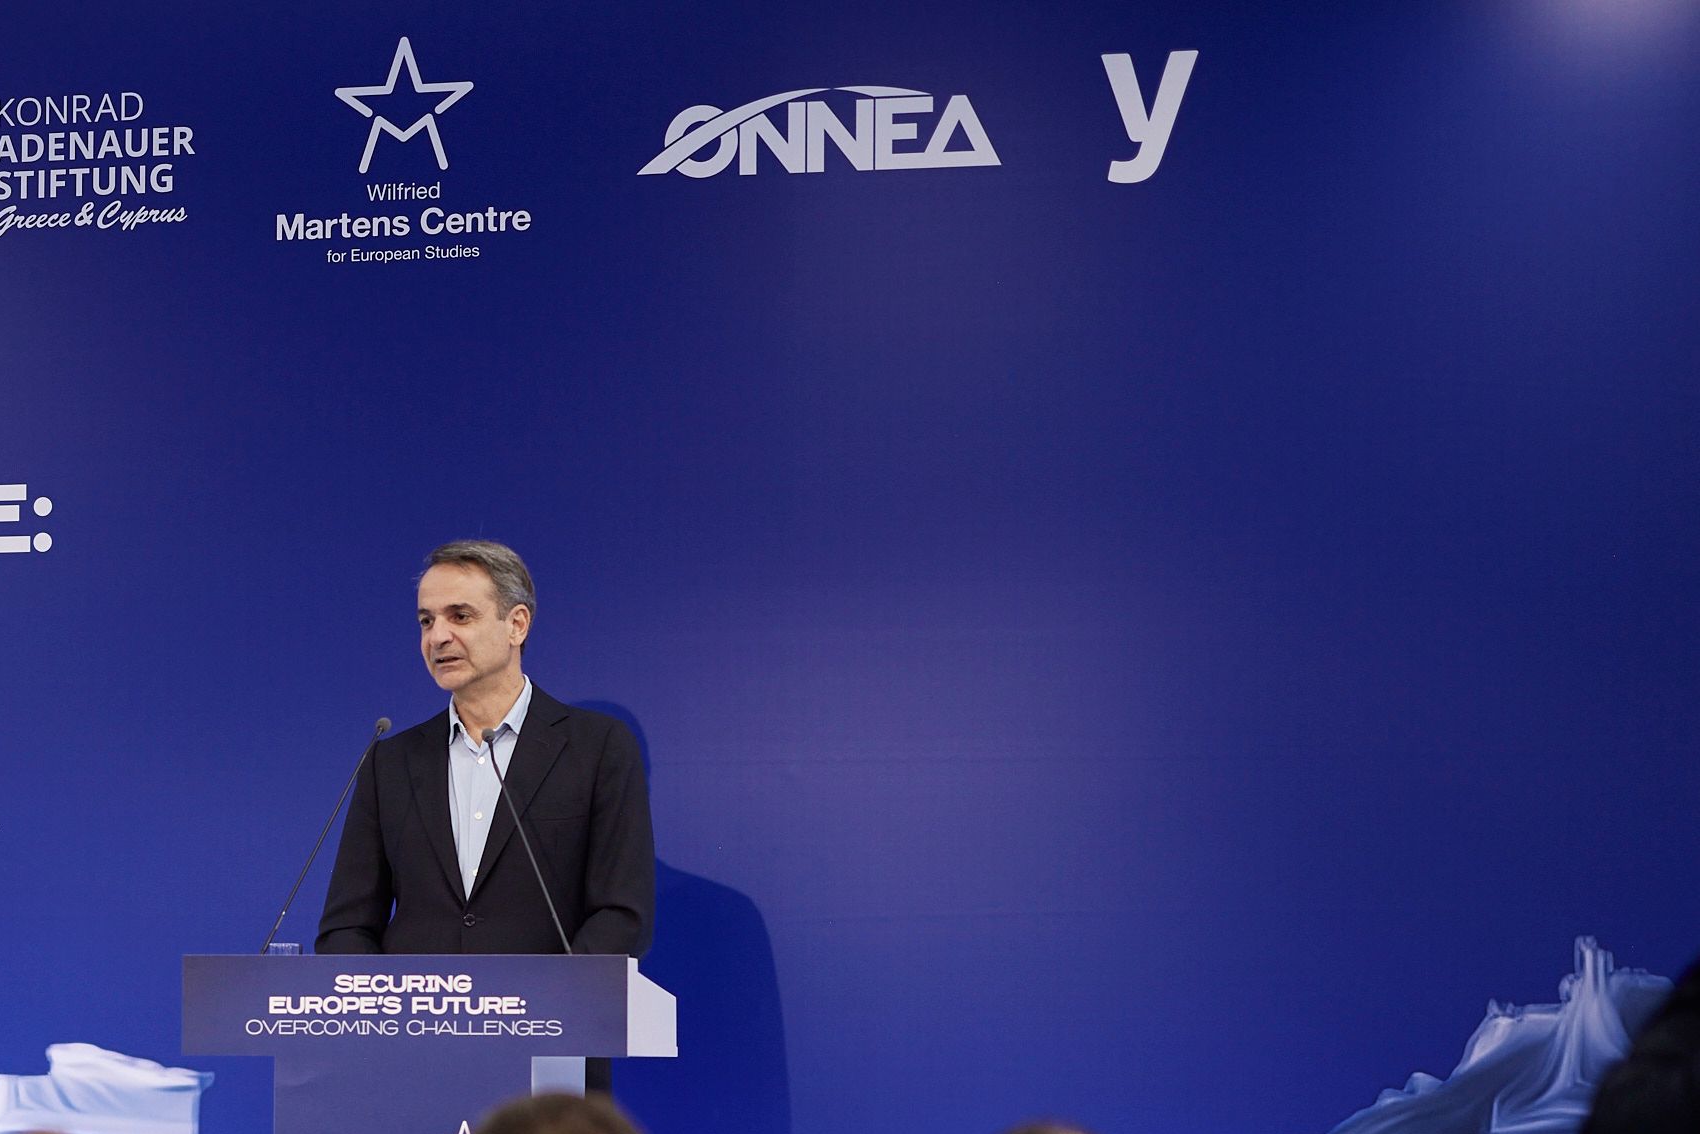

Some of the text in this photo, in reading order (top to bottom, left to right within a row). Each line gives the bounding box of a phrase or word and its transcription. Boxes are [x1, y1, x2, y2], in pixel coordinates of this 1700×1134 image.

[367, 181, 441, 202] Wilfried
[74, 202, 94, 228] &
[97, 200, 188, 232] Cyprus
[276, 206, 532, 241] Martens Centre
[326, 244, 480, 264] for European Studies
[333, 974, 473, 994] SECURING
[268, 996, 526, 1015] EUROPE'S FUTURE:
[245, 1018, 563, 1037] OVERCOMING CHALLENGES
